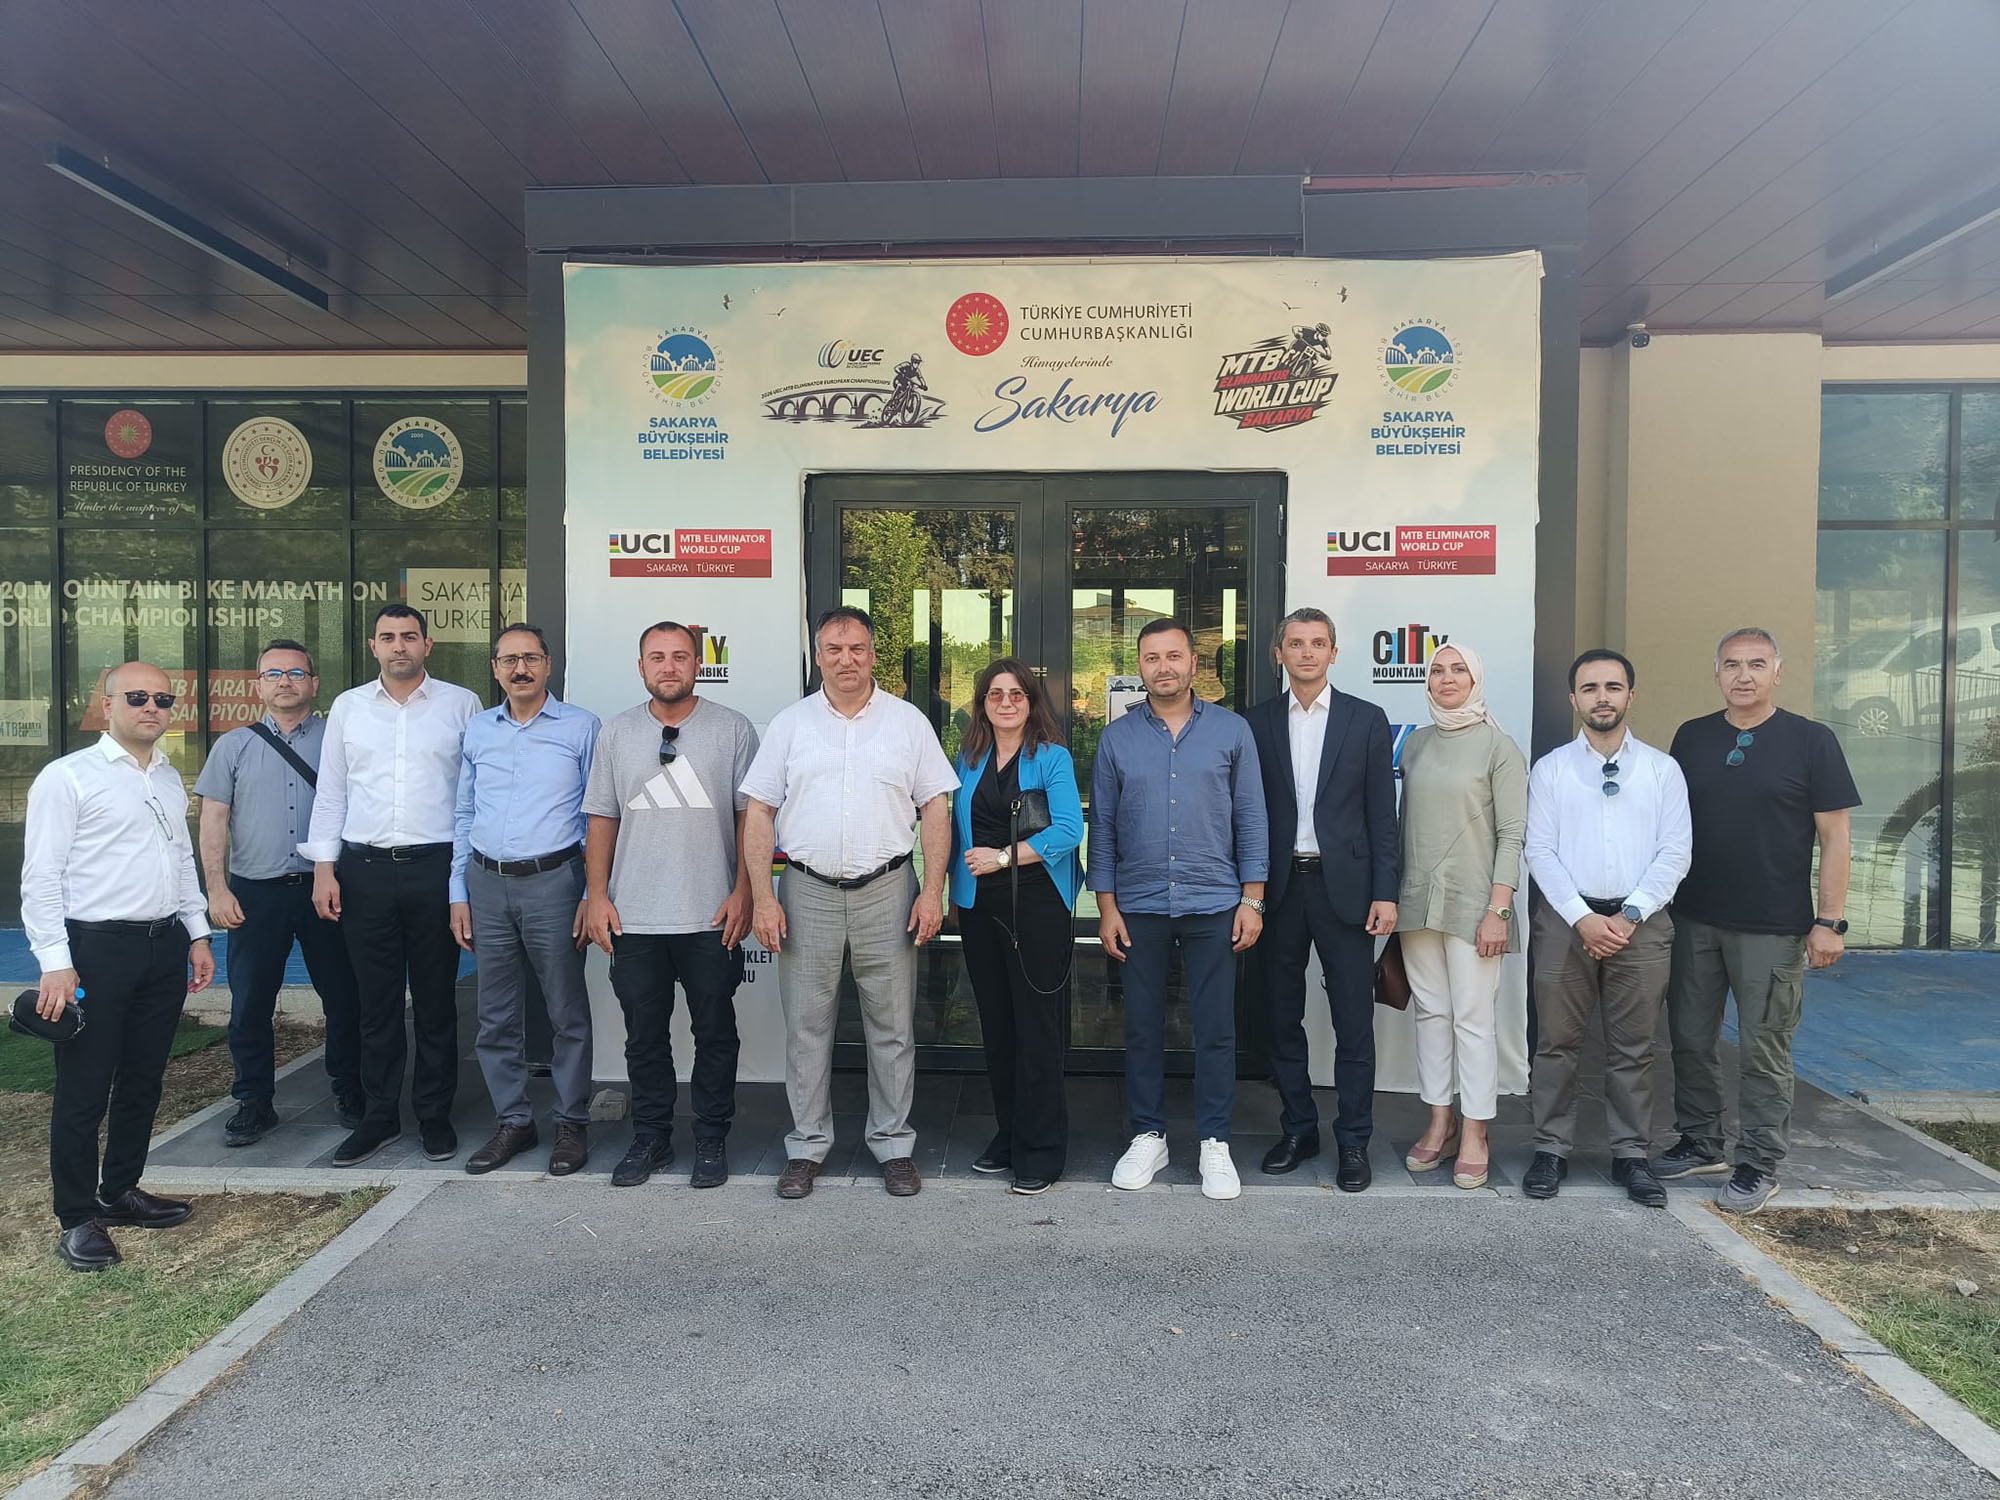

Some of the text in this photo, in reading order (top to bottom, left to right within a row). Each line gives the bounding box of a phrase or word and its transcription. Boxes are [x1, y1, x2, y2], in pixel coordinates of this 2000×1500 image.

[1020, 302, 1192, 320] TÜRKİYE CUMHURİYETİ
[1020, 323, 1193, 342] CUMHURBAŞKANLIĞI
[1392, 318, 1446, 333] SAKARYA
[848, 349, 884, 362] UEC
[1020, 355, 1113, 371] Himayelerinde
[1219, 348, 1286, 377] MTB
[1218, 369, 1291, 389] ELIMINATOR
[1215, 377, 1333, 413] WORLD CUP
[973, 376, 1164, 438] Sakarya
[649, 417, 717, 428] SAKARYA
[1239, 405, 1313, 428] SAKARYA
[1383, 411, 1454, 422] SAKARYA
[389, 421, 447, 438] SAKARYA
[638, 430, 728, 445] BÜYÜKŞEHİR
[1371, 424, 1466, 440] BÜYÜKŞEHİR
[643, 447, 724, 460] BELEDİYESİ
[1376, 441, 1461, 455] BELEDİYESİ
[70, 465, 187, 477] PRESIDENCY OF THE
[70, 480, 187, 493] REPUBLIC OF TURKEY
[74, 502, 106, 512] Under
[108, 502, 123, 512] the
[168, 503, 181, 516] of
[620, 534, 766, 553] UCI MTB ELIMINATOR
[1339, 530, 1490, 552] UCI MTB ELIMINATOR
[1401, 542, 1464, 551] WORLD CUP
[680, 545, 741, 554] WORLD CUP
[646, 563, 689, 573] SAKARYA
[1365, 561, 1409, 571] SAKARYA
[178, 580, 235, 600] BIKE
[242, 579, 387, 601] MARATHON
[421, 582, 525, 601] SAKARYA
[75, 607, 284, 628] CHAMPIONSHIPS
[421, 609, 511, 629] TURKEY
